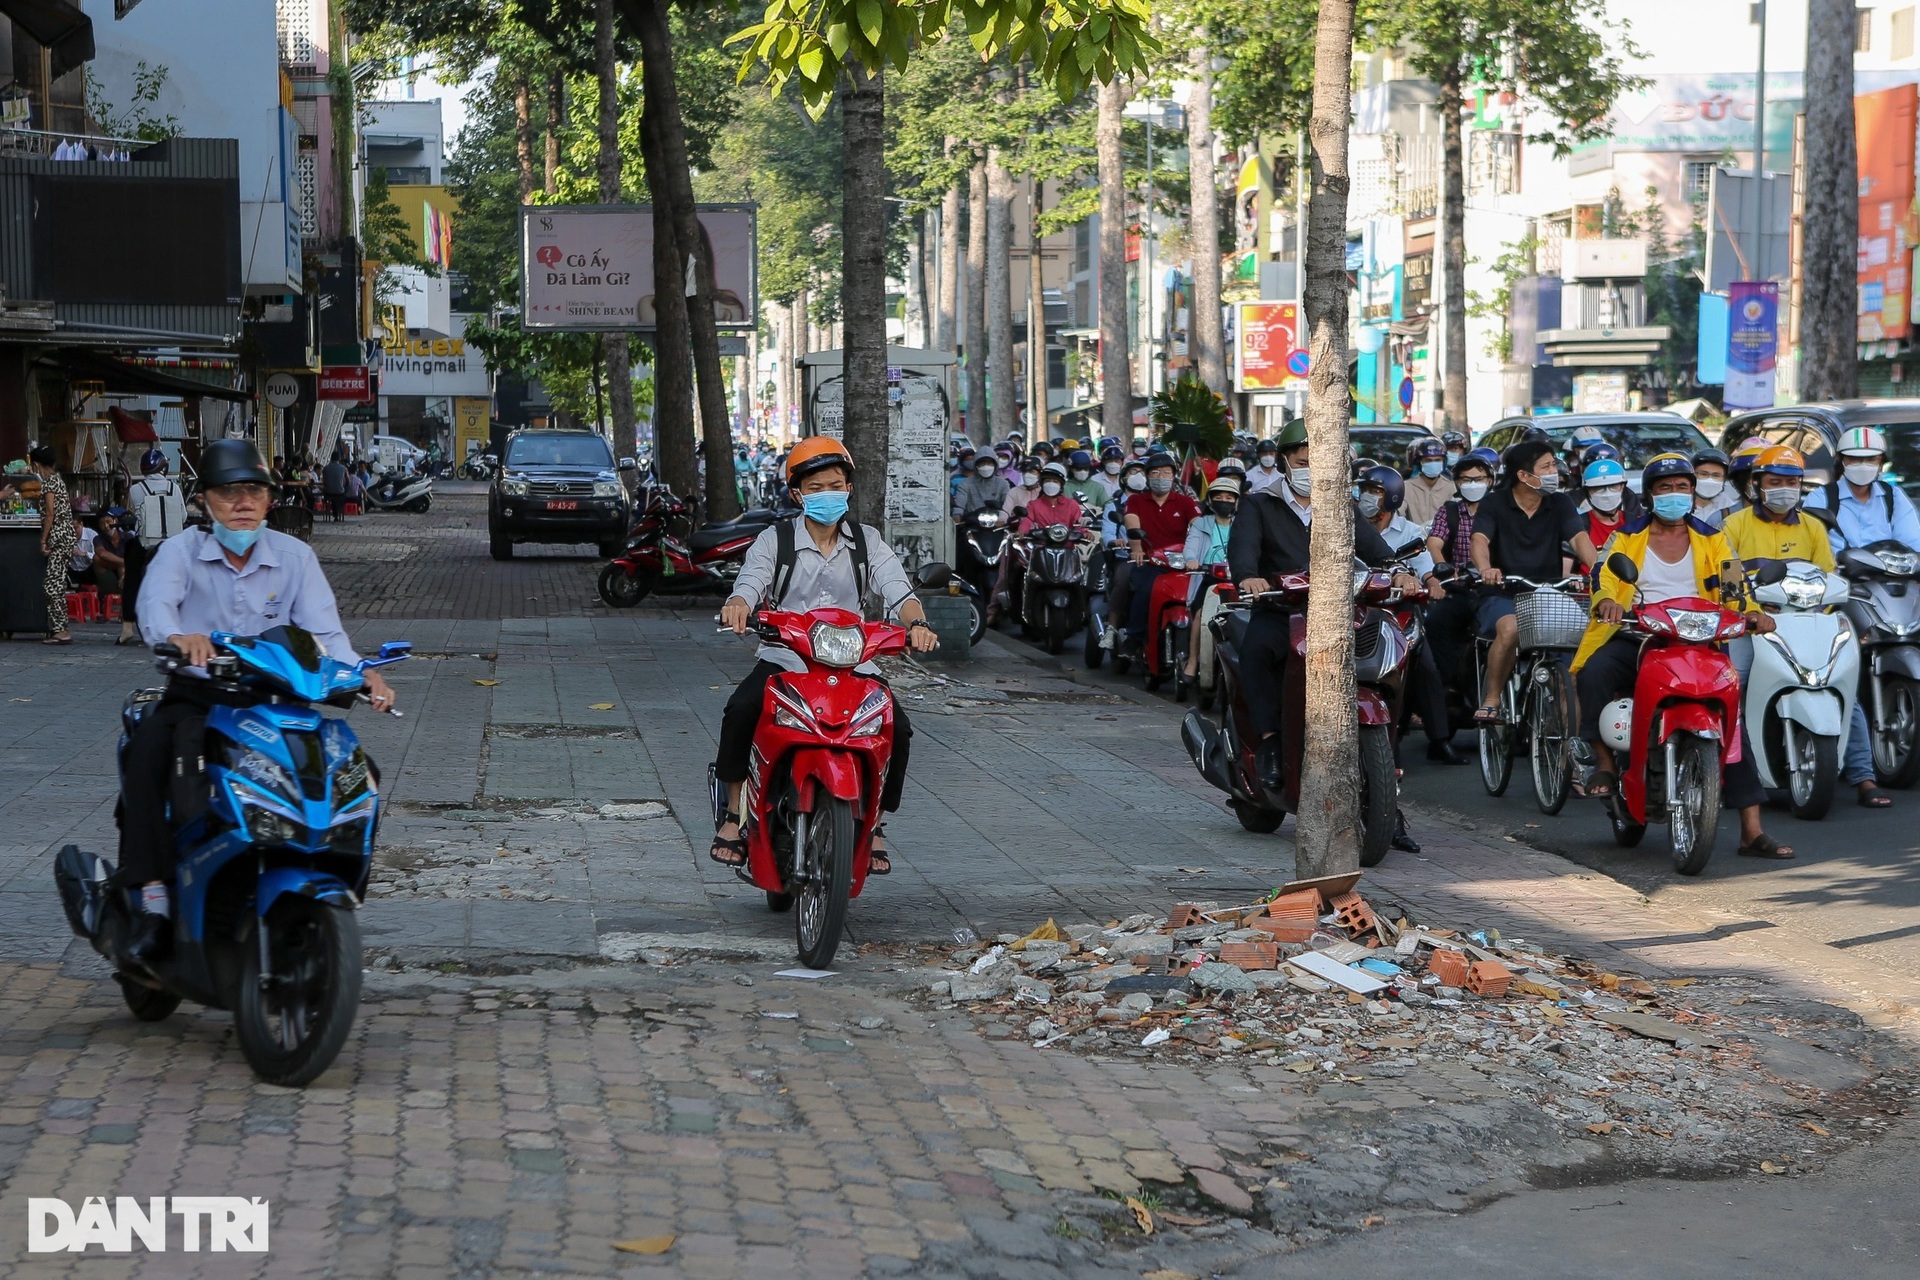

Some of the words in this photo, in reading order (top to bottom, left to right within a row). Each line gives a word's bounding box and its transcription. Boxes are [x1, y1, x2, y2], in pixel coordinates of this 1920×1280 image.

[566, 254, 586, 267] Cô
[590, 248, 609, 271] Ấy
[547, 272, 566, 285] Đã
[572, 272, 601, 285] Làm
[606, 272, 630, 285] Gì?
[568, 307, 601, 316] SHINE
[603, 307, 634, 316] BEAM
[1246, 333, 1269, 350] 92
[385, 358, 466, 375] livingmall
[267, 385, 296, 396] PUMI
[243, 721, 275, 741] MOTUL
